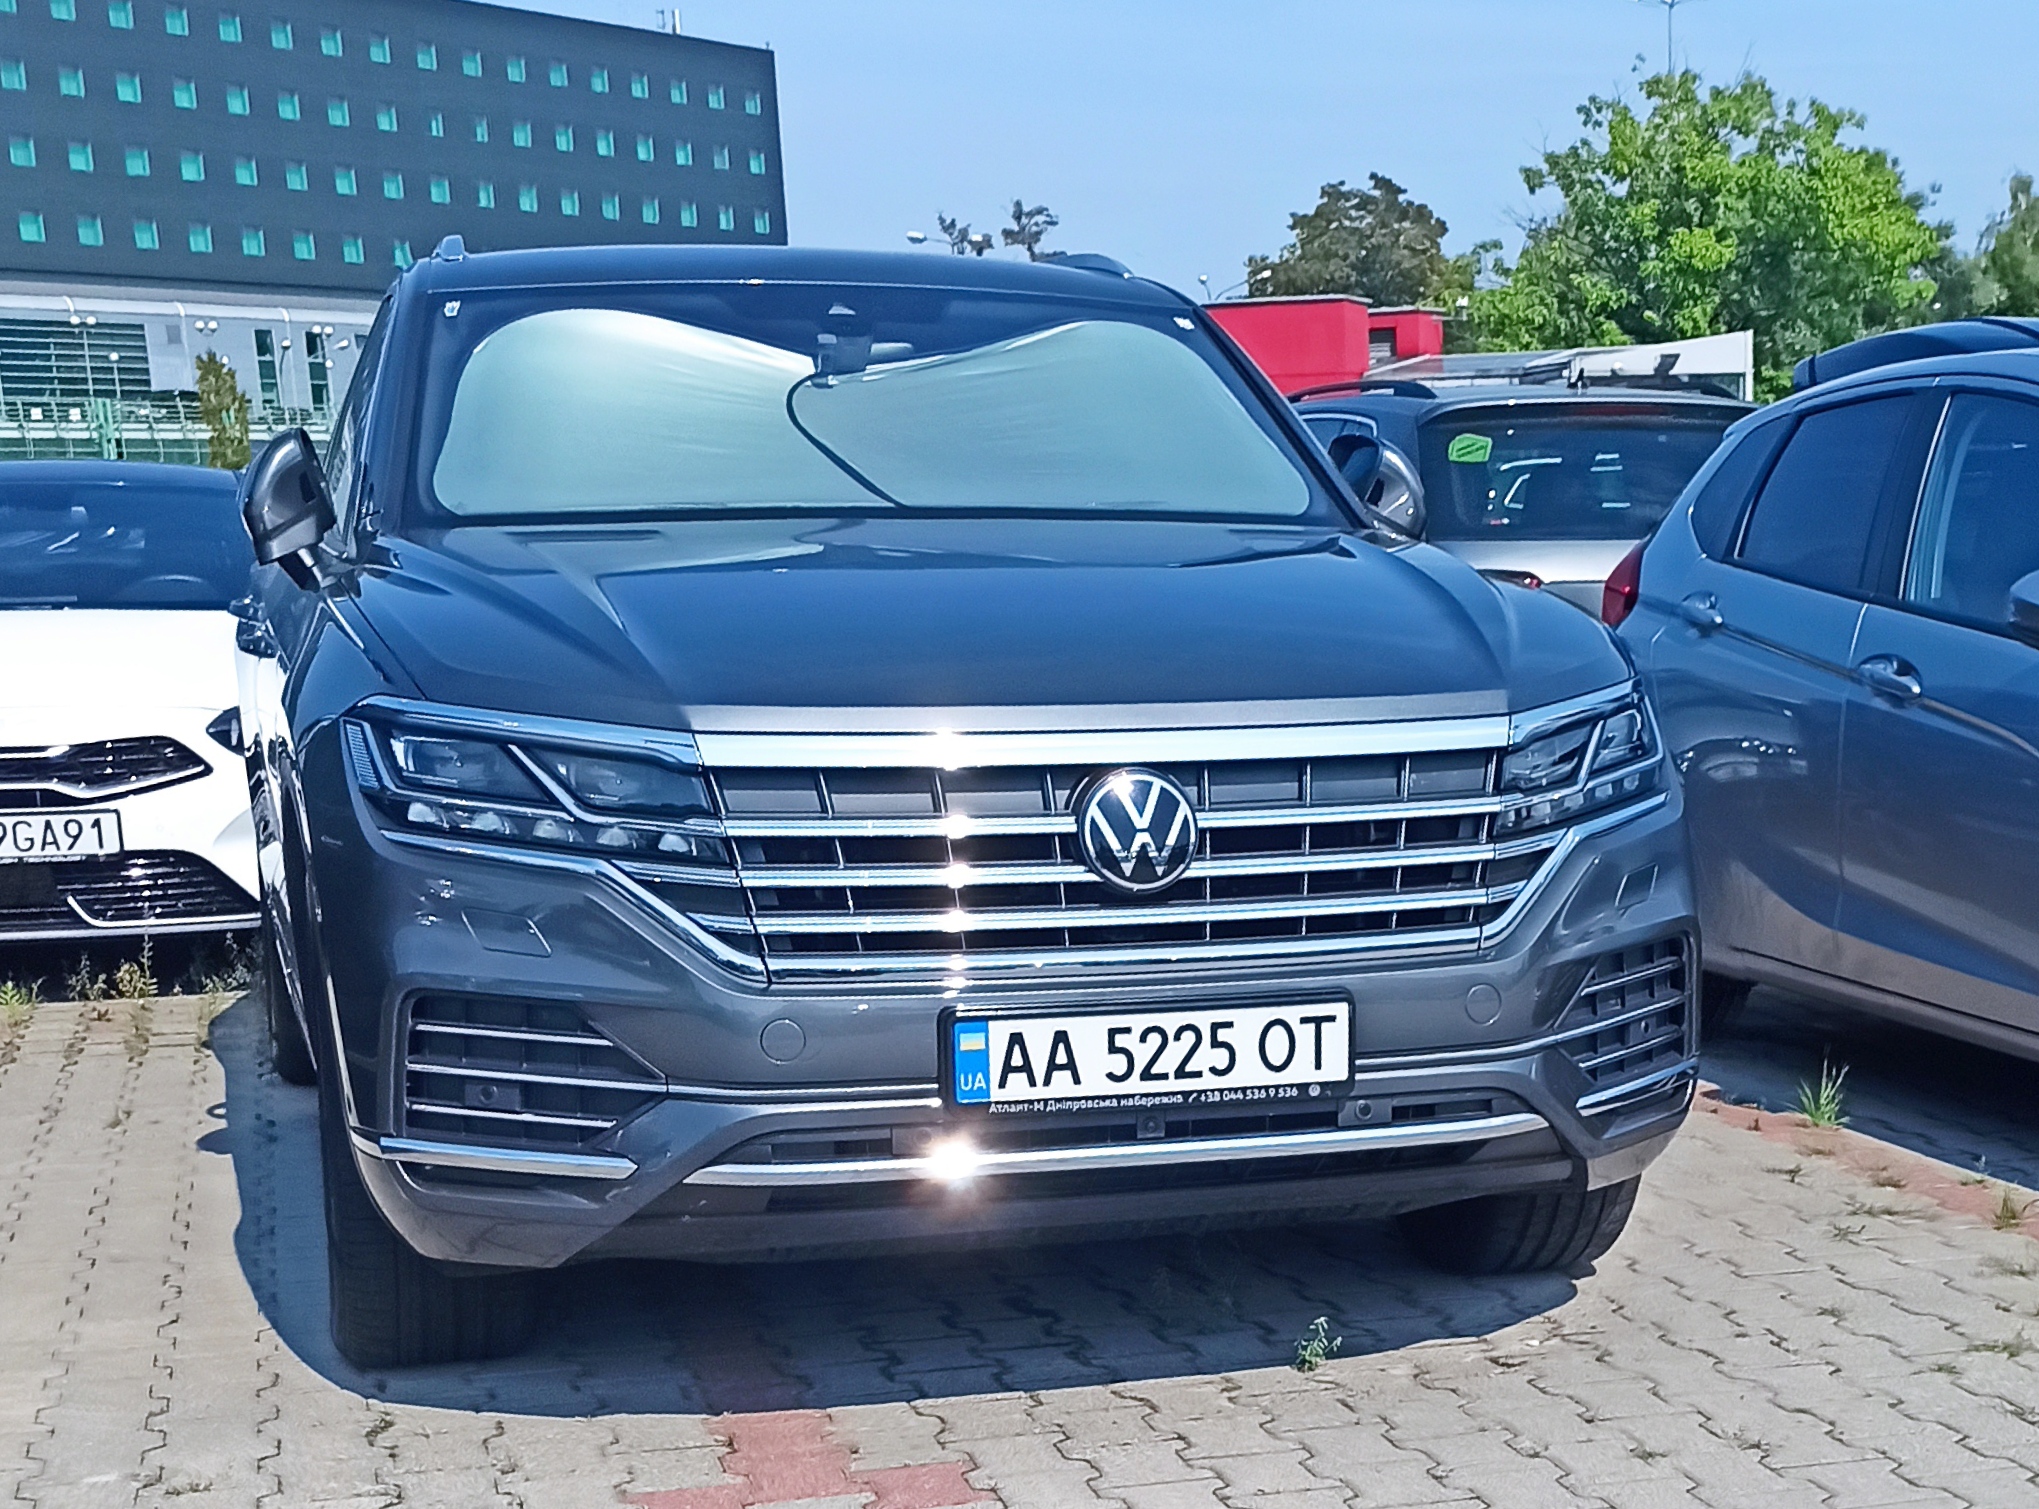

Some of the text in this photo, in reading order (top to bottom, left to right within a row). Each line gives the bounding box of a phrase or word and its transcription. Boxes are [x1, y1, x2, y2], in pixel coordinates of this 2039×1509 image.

[997, 1014, 1337, 1089] AA 5225 OT
[960, 1072, 987, 1091] UA
[1223, 1089, 1244, 1101] 044
[1245, 1087, 1267, 1100] 536
